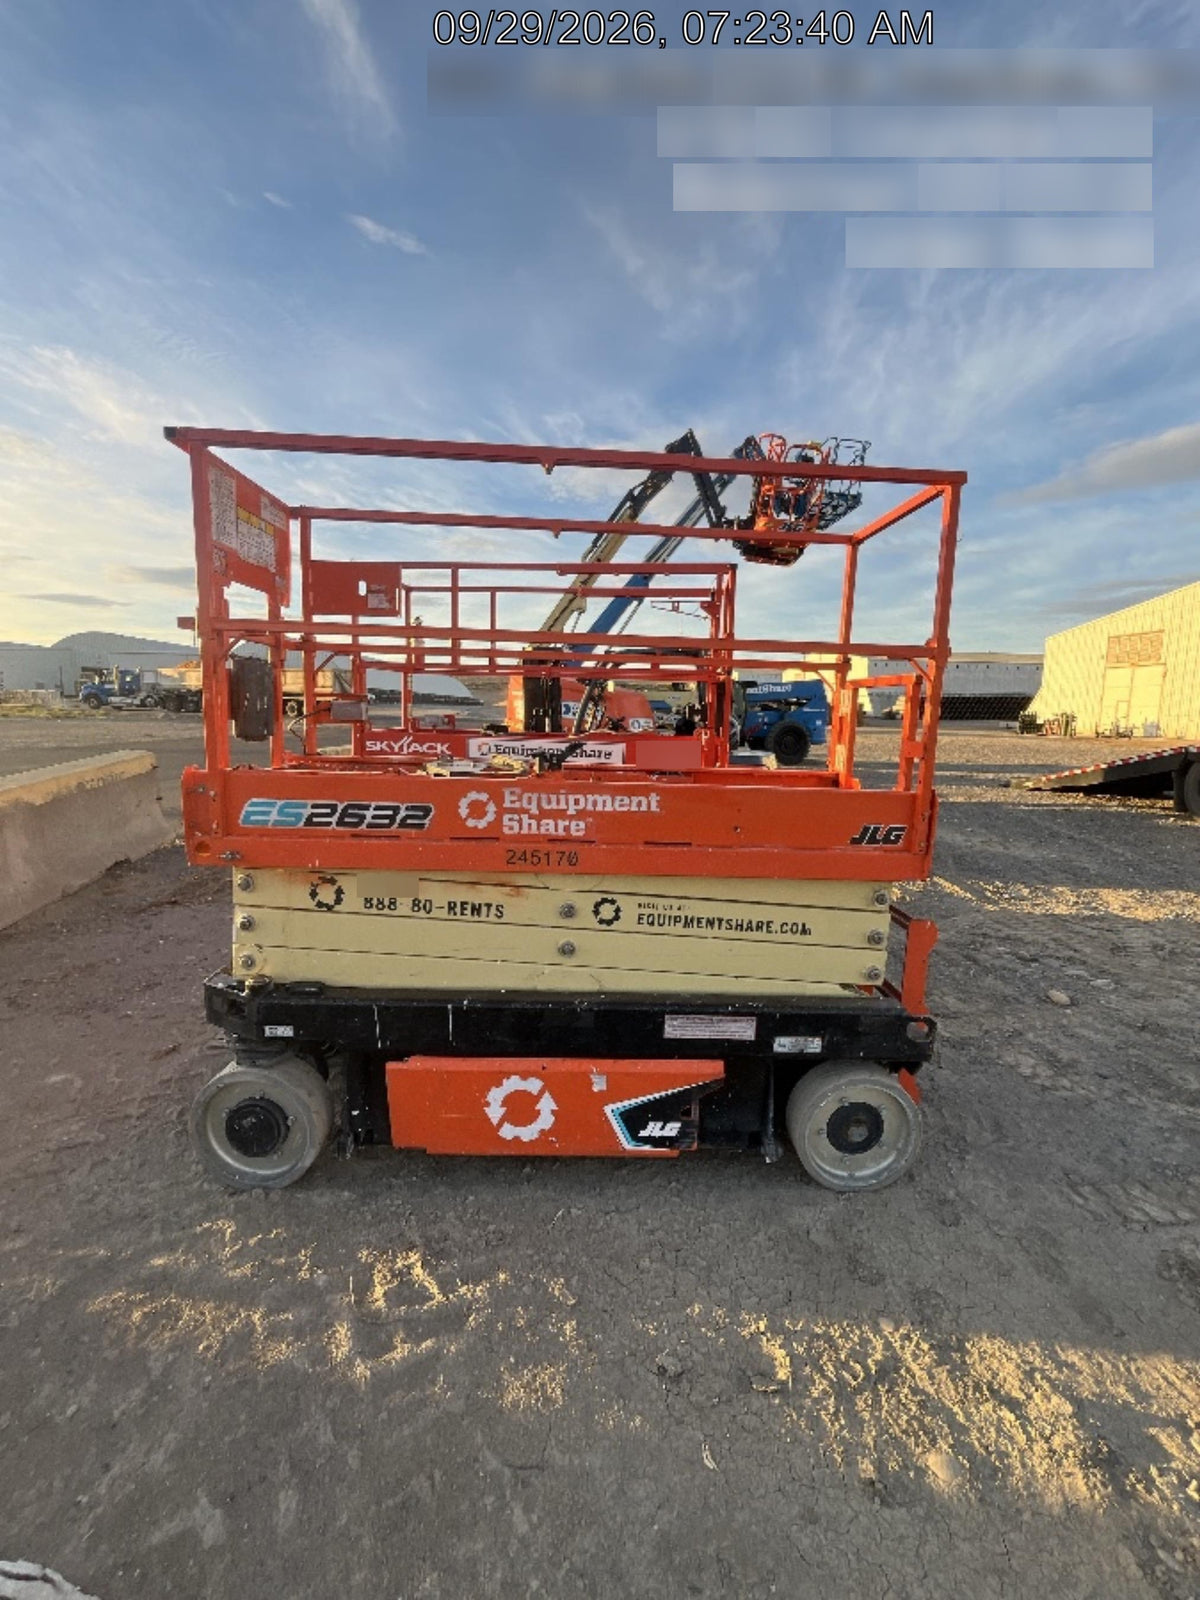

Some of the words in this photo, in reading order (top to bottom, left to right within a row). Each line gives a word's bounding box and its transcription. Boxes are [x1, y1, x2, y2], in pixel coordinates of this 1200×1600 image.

[365, 735, 452, 755] SKYJACK
[502, 787, 661, 814] Equipment
[238, 798, 434, 831] ES2632
[502, 814, 586, 836] Share
[850, 823, 909, 846] JLG
[506, 849, 579, 866] 245170
[637, 1120, 682, 1137] JLG
